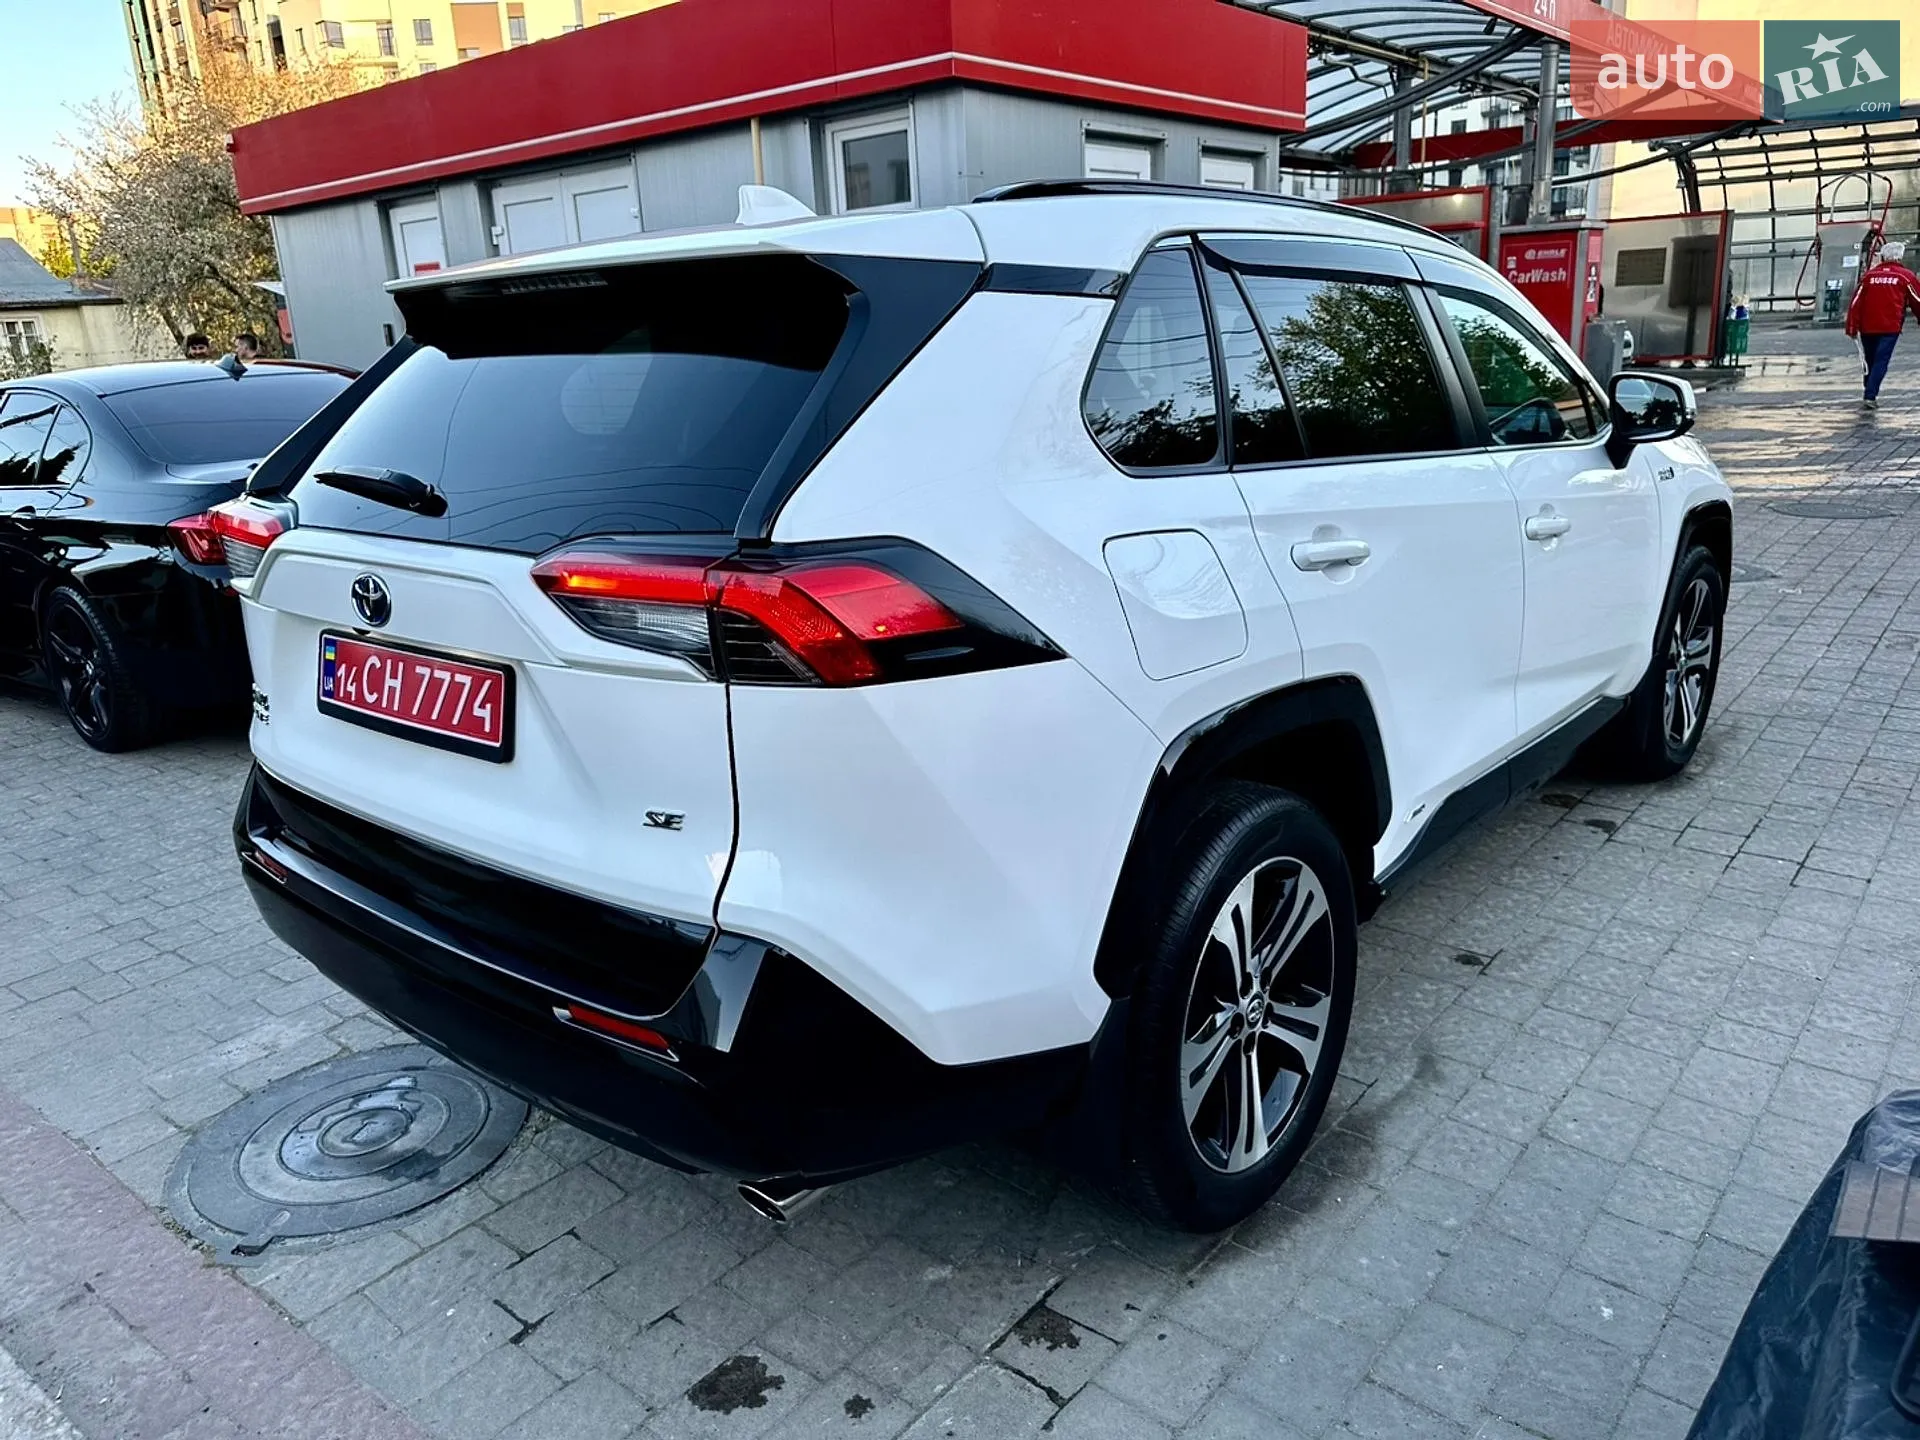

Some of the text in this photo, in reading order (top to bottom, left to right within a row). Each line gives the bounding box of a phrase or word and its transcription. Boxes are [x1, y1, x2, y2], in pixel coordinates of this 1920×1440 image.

[1507, 267, 1567, 284] CarWash
[1870, 277, 1899, 285] SUISSE
[324, 676, 334, 691] UA
[337, 655, 493, 733] 14 CH 7774
[643, 811, 685, 831] SE
